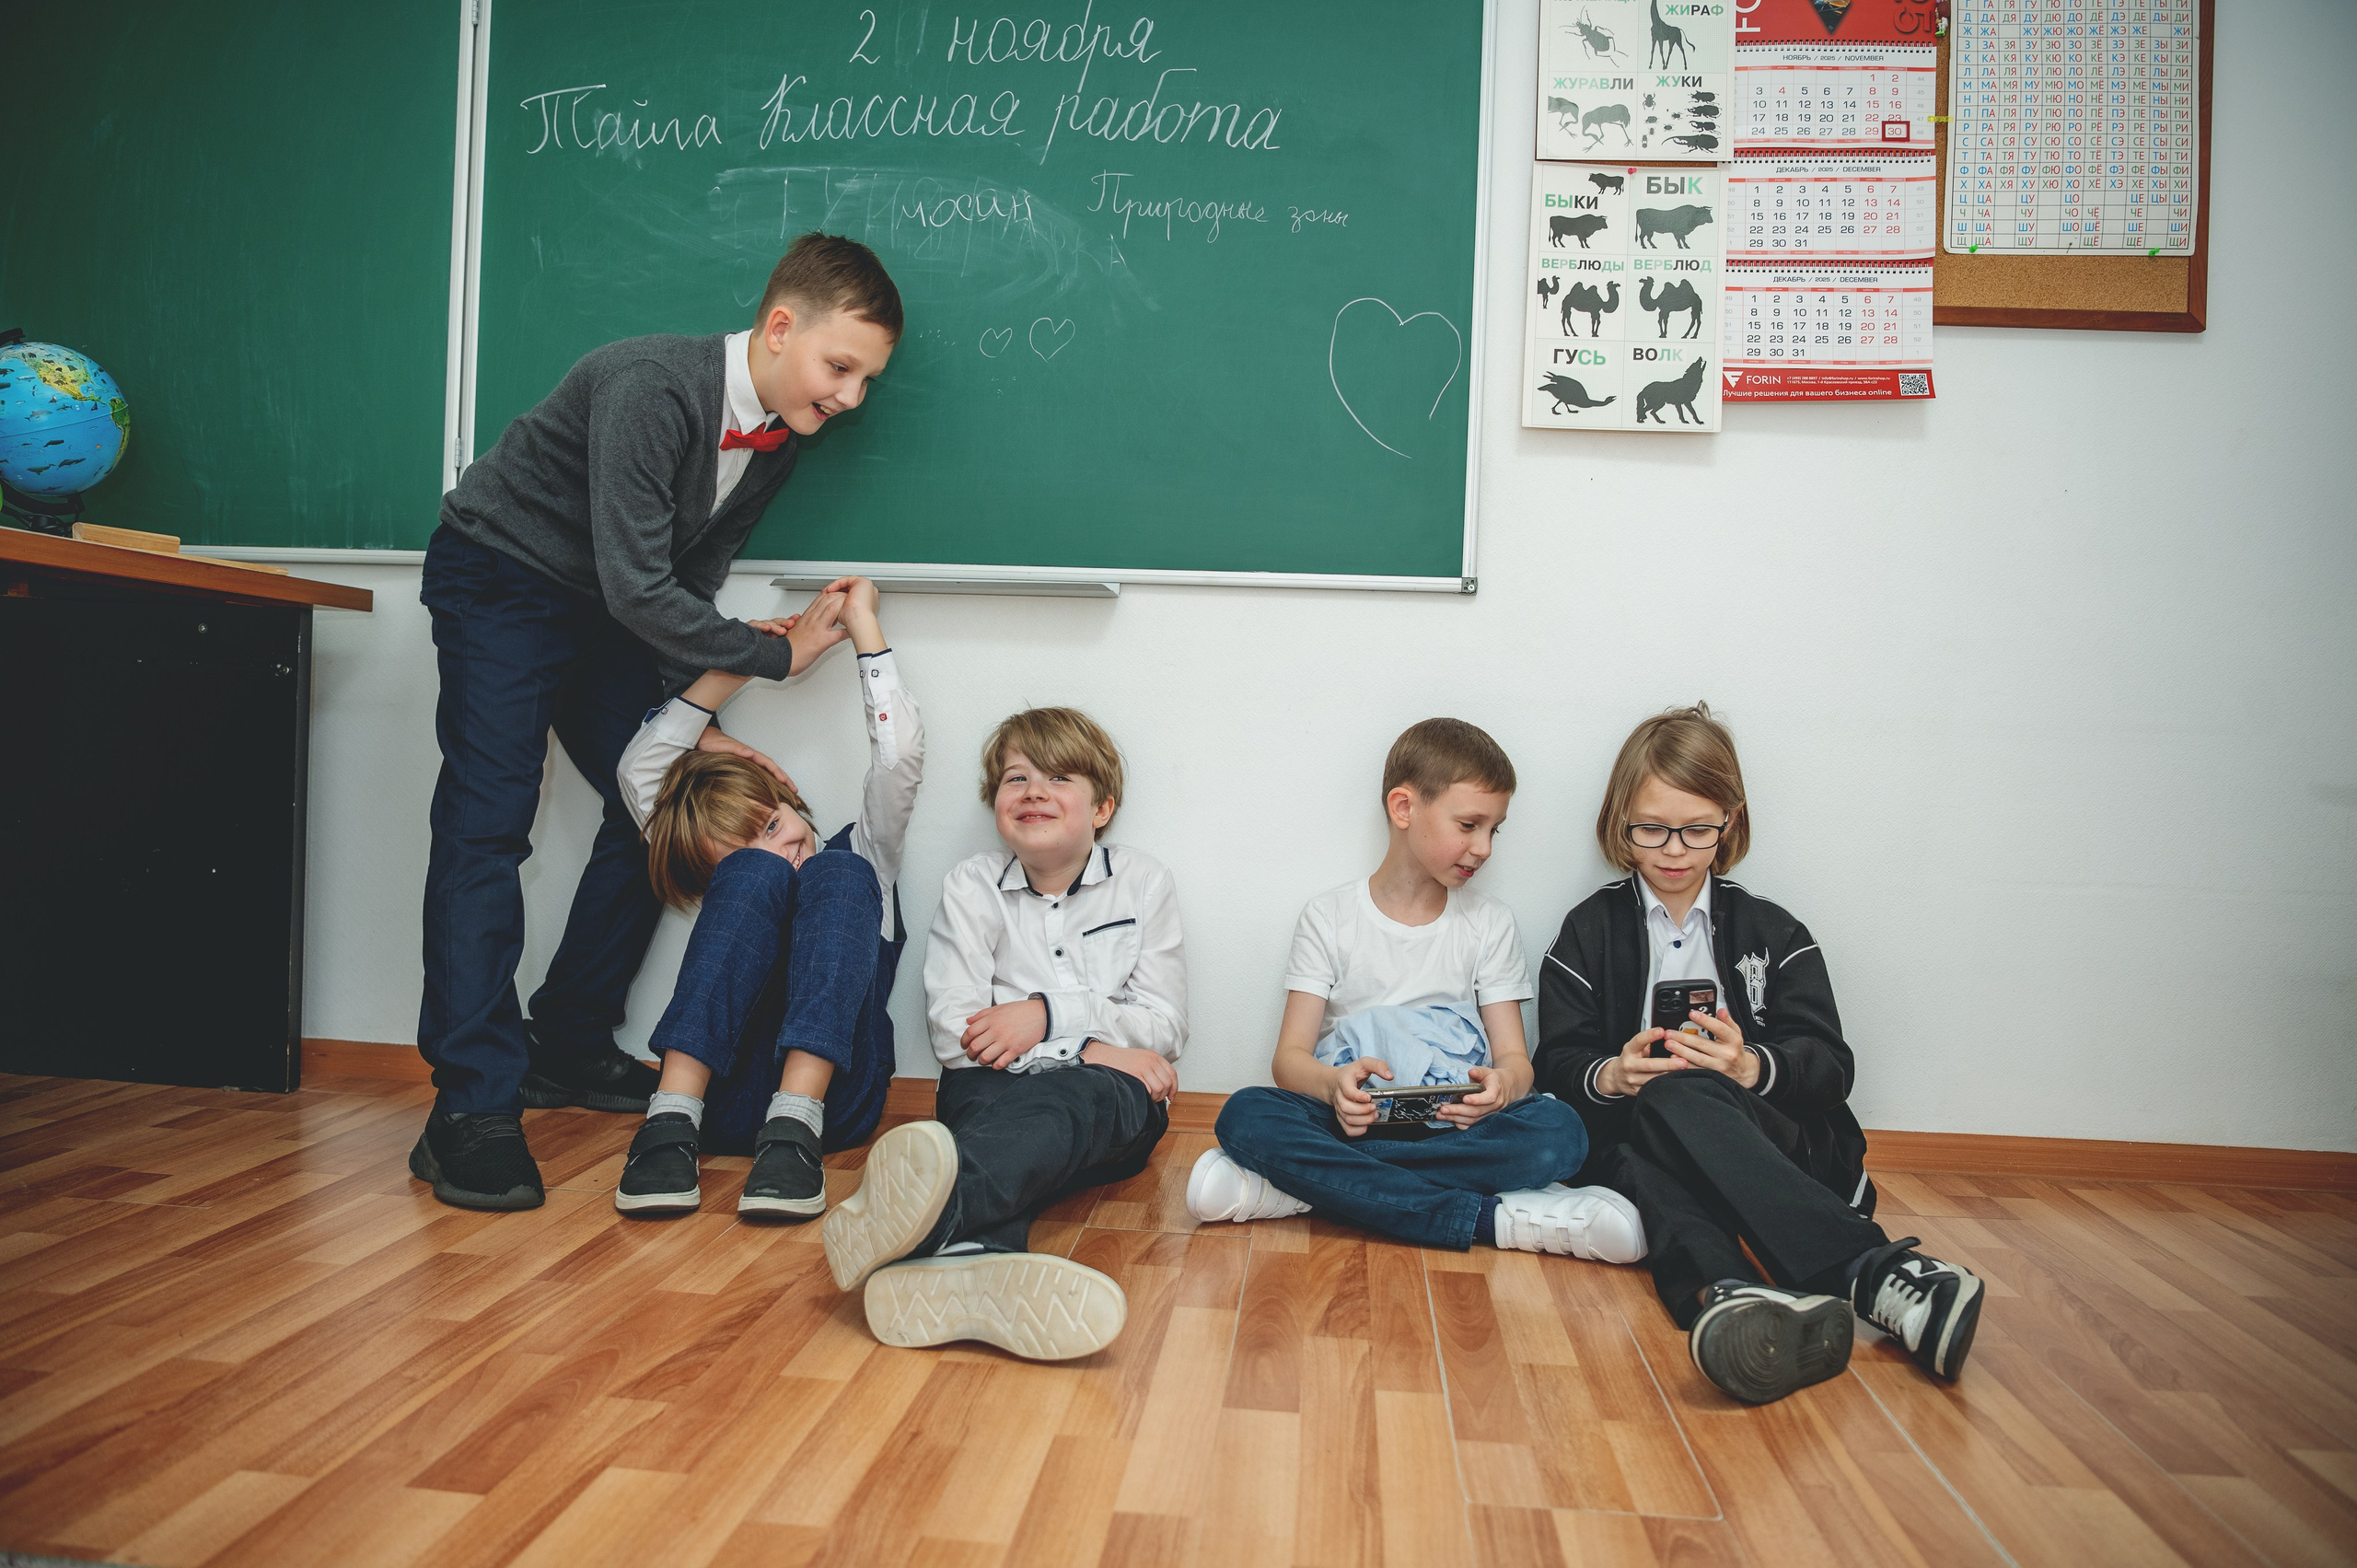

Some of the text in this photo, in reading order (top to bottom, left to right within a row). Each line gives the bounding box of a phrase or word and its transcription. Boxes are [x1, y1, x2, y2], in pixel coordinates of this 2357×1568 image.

[1665, 4, 1724, 16] ЖИРАФ
[1963, 24, 2190, 36] Ж ЖА ЖУ ЖЮ ЖО ЖЁ ЖЭ ЖЕ ЖИ
[848, 0, 1162, 93] 2 ноября
[1552, 75, 1702, 89] ЖУРАВЛИ ЖУКИ
[1891, 75, 1899, 83] 2
[1963, 79, 2189, 90] М МА МЯ МУ МЮ МО МЁ МЭ МЕ МЫ МИ
[1756, 87, 1763, 96] 3
[1801, 87, 1808, 96] 5
[1823, 87, 1831, 96] 6
[1846, 87, 1853, 96] 7
[1869, 87, 1876, 96] 8
[1753, 100, 1767, 109] 10
[1775, 100, 1788, 109] 11
[1798, 100, 1812, 109] 12
[1820, 101, 1834, 110] 13
[1866, 100, 1880, 109] 15
[1888, 101, 1902, 110] 16
[760, 68, 1283, 166] Классная работа
[1752, 114, 1766, 122] 17
[1797, 114, 1811, 122] 19
[1819, 114, 1834, 122] 20
[1841, 114, 1855, 122] 21
[1864, 113, 1880, 122] 22
[1887, 114, 1902, 122] 23
[1774, 127, 1789, 135] 25
[1796, 127, 1811, 135] 26
[1818, 128, 1833, 136] 27
[1864, 127, 1880, 136] 29
[1887, 127, 1903, 136] 30
[1959, 164, 2189, 175] Ф ФА ФЯ ФУ ФЮ ФО ФЁ ФЭ ФЕ ФЫ ФИ
[1646, 176, 1703, 195] БЫК
[1545, 194, 1598, 210] БЫКИ
[1959, 194, 2189, 203] Ц ЦА ЦУ ЦО ЦЕ ЦЫ ЦИ
[1087, 169, 1269, 243] Природные
[1960, 206, 2187, 217] Ч ЧА ЧУ ЧО ЧЁ ЧЕ ЧИ
[1749, 226, 1764, 235] 22
[1771, 226, 1786, 235] 23
[1817, 226, 1832, 234] 25
[1840, 226, 1855, 234] 26
[1863, 226, 1877, 234] 27
[1886, 226, 1900, 234] 28
[1957, 220, 2188, 232] Ш ША ШУ ШО ШЁ ШЕ ШИ
[1541, 258, 1713, 273] ВЕРБЛЮДЫ ВЕРБЛЮД
[1553, 347, 1684, 366] ГУСЬ ВОЛК
[1747, 348, 1805, 357] 29 30 31
[1747, 376, 1781, 385] FORIN
[1723, 389, 1752, 398] Лучшие
[1805, 389, 1833, 398] вашего
[1835, 389, 1867, 397] бизнеса
[1868, 389, 1892, 397] online
